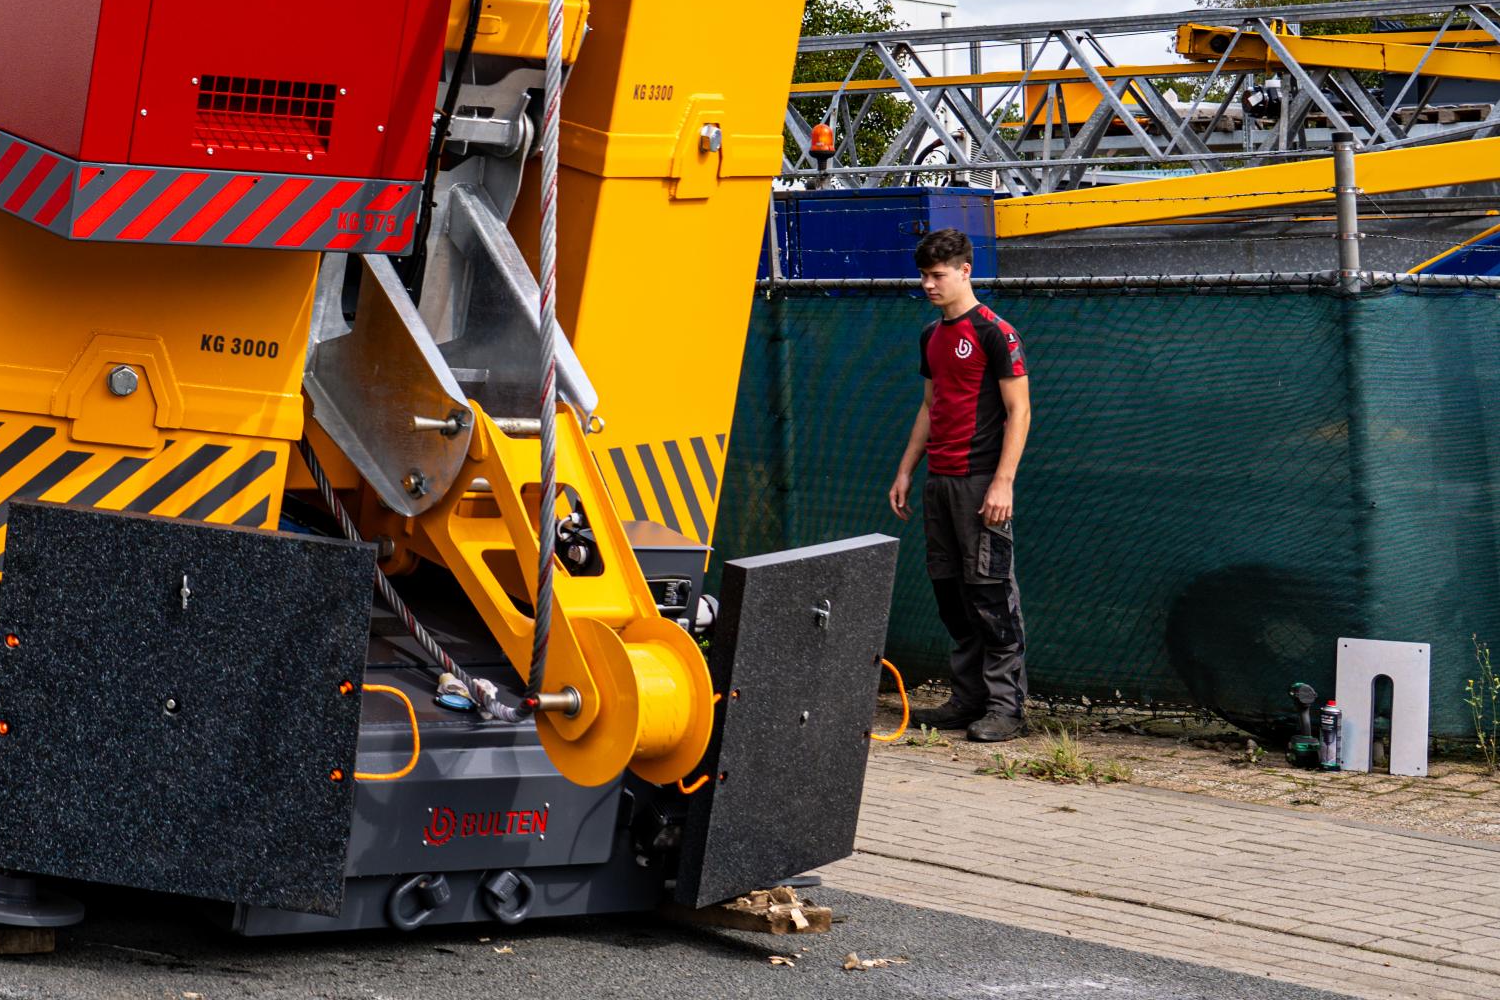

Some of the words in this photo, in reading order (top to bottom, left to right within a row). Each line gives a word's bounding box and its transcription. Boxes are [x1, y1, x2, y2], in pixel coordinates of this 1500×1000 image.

[633, 84, 647, 101] KG
[648, 84, 673, 101] 3300
[337, 212, 360, 232] KG
[363, 213, 397, 233] 975
[200, 333, 226, 353] KG
[230, 337, 280, 359] 3000
[460, 810, 549, 838] BULTEN
